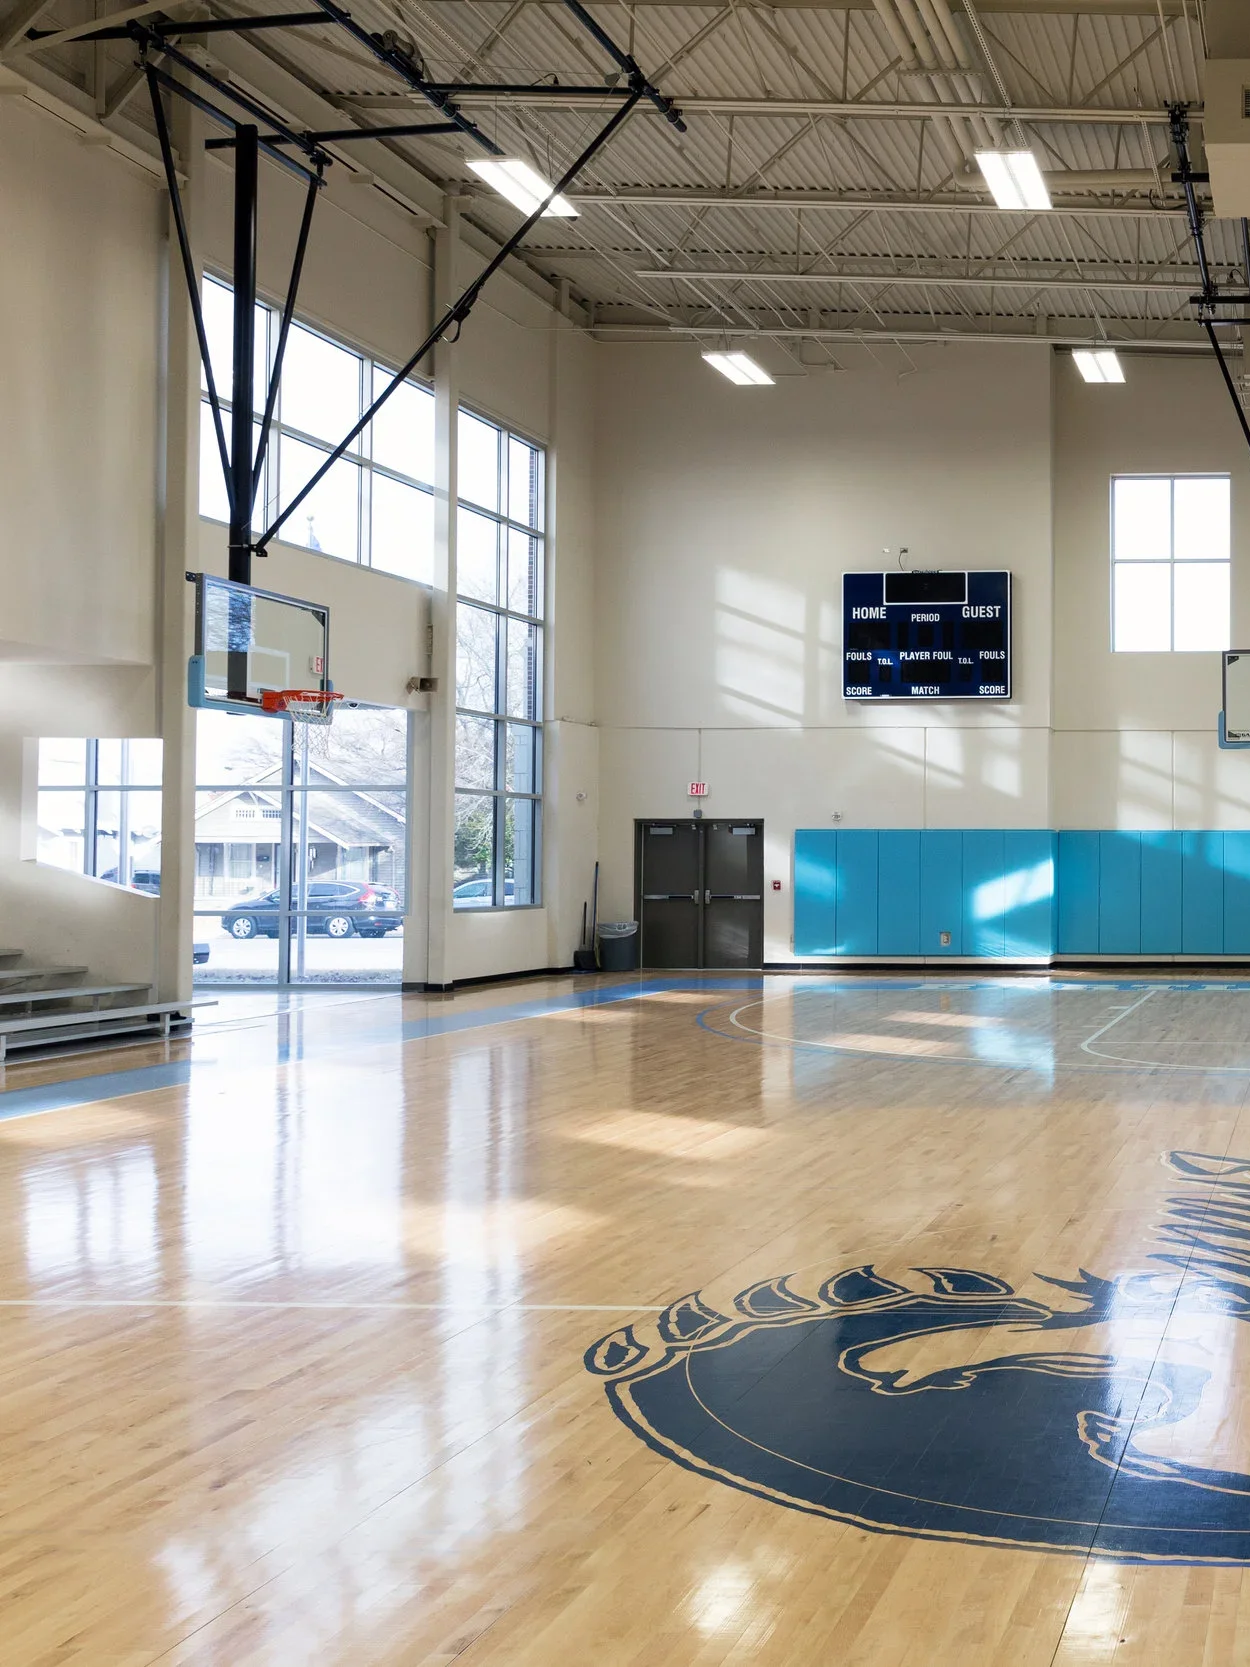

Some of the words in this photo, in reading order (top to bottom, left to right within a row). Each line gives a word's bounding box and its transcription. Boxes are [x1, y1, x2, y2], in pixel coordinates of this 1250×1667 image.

[852, 607, 887, 619] HOME
[962, 606, 1001, 618] GUEST
[911, 613, 940, 622] PERIOD
[846, 652, 872, 661] FOULS
[899, 651, 930, 660] PLAYER
[932, 651, 953, 660] FOUL
[979, 650, 1005, 660] FOULS
[846, 686, 872, 695] SCORE
[911, 686, 940, 695] MATCH
[979, 685, 1005, 694] SCORE
[691, 783, 705, 794] EXIT
